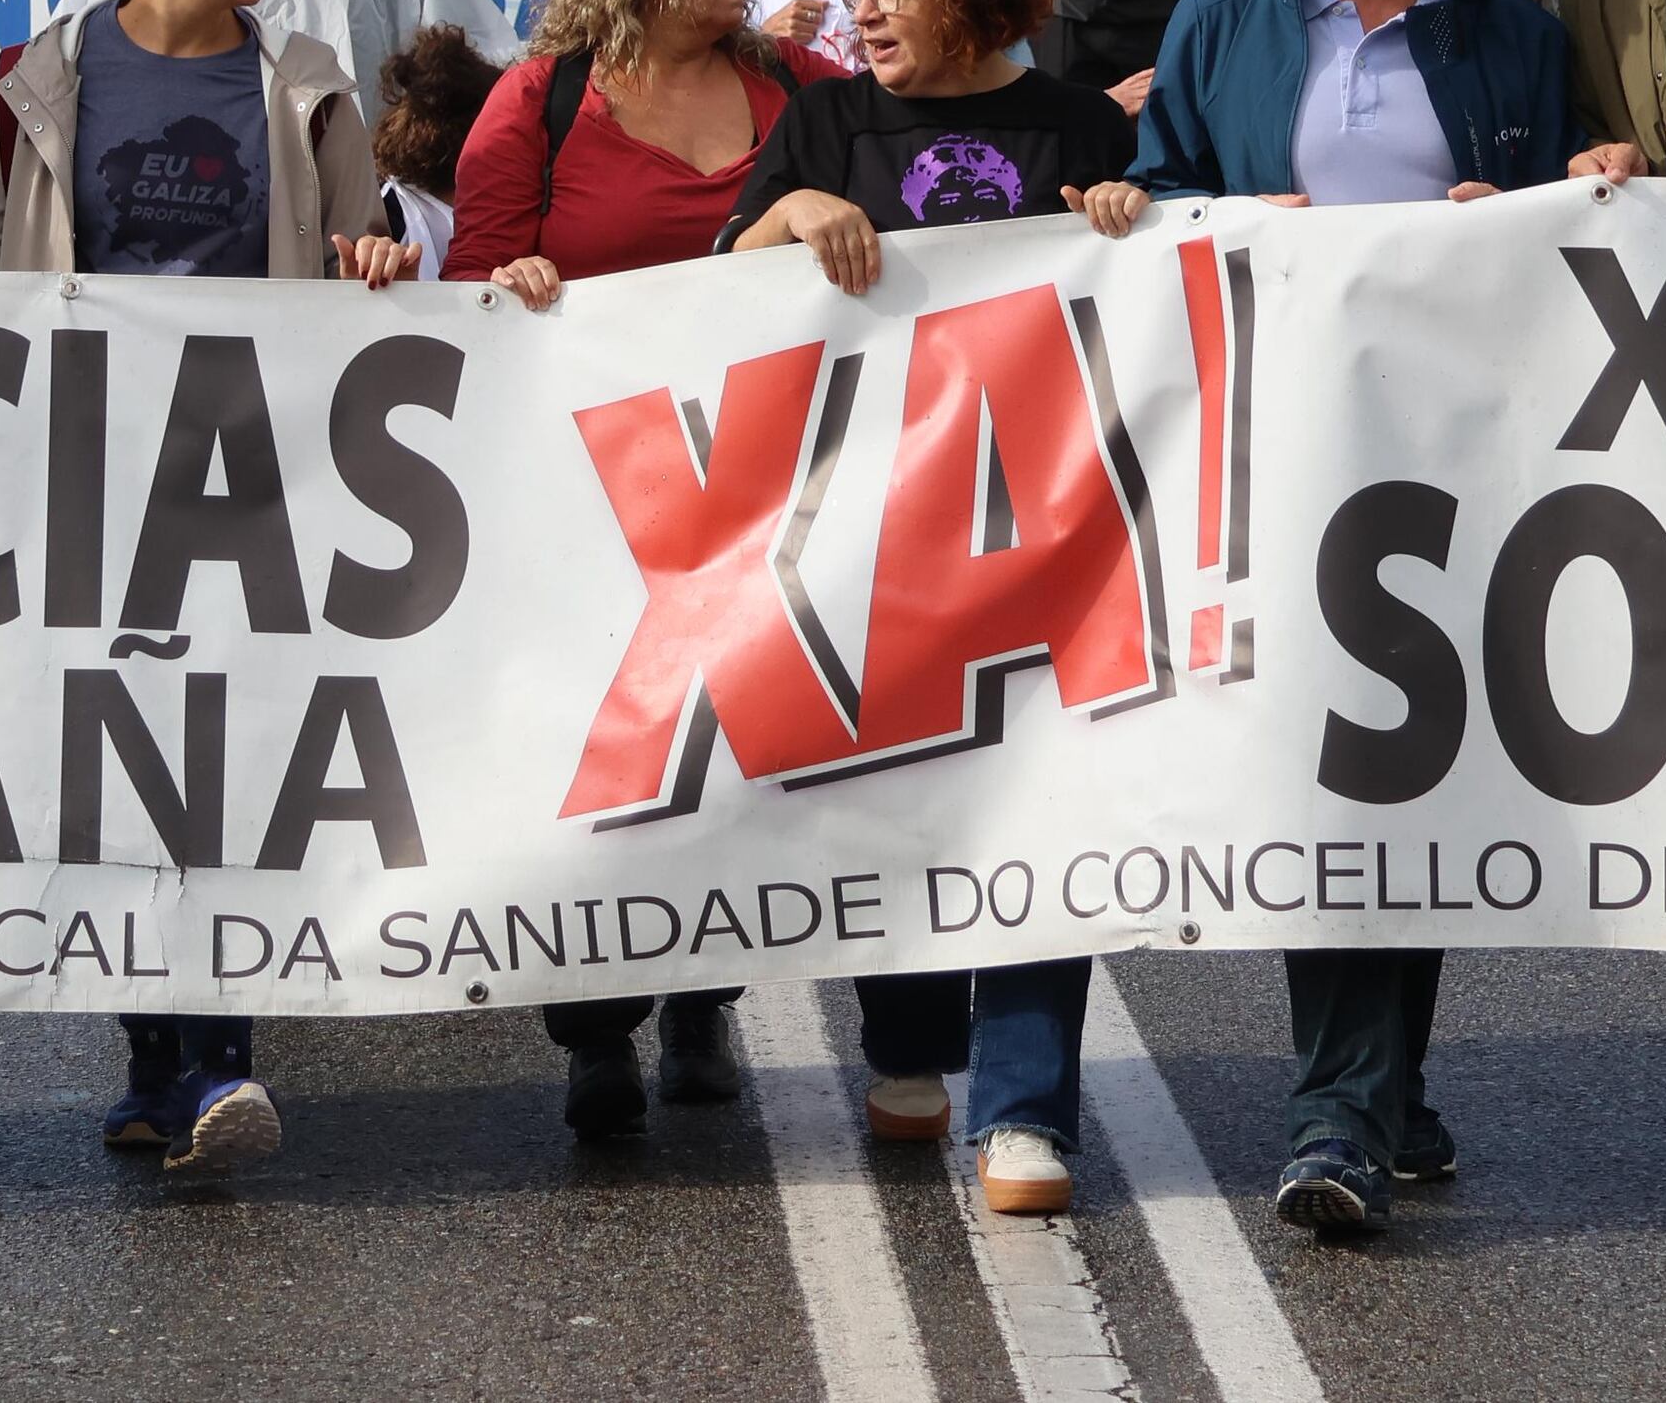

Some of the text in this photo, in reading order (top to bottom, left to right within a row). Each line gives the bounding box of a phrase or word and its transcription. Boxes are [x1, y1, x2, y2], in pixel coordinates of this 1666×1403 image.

[140, 153, 190, 178] EU
[132, 181, 232, 207] GALIZA
[129, 205, 230, 229] PROFUNDA
[558, 234, 1256, 834] XA!
[212, 914, 342, 981] DA
[379, 873, 886, 978] SANIDADE
[926, 860, 1035, 934] DO
[1063, 840, 1542, 918] CONCELLO
